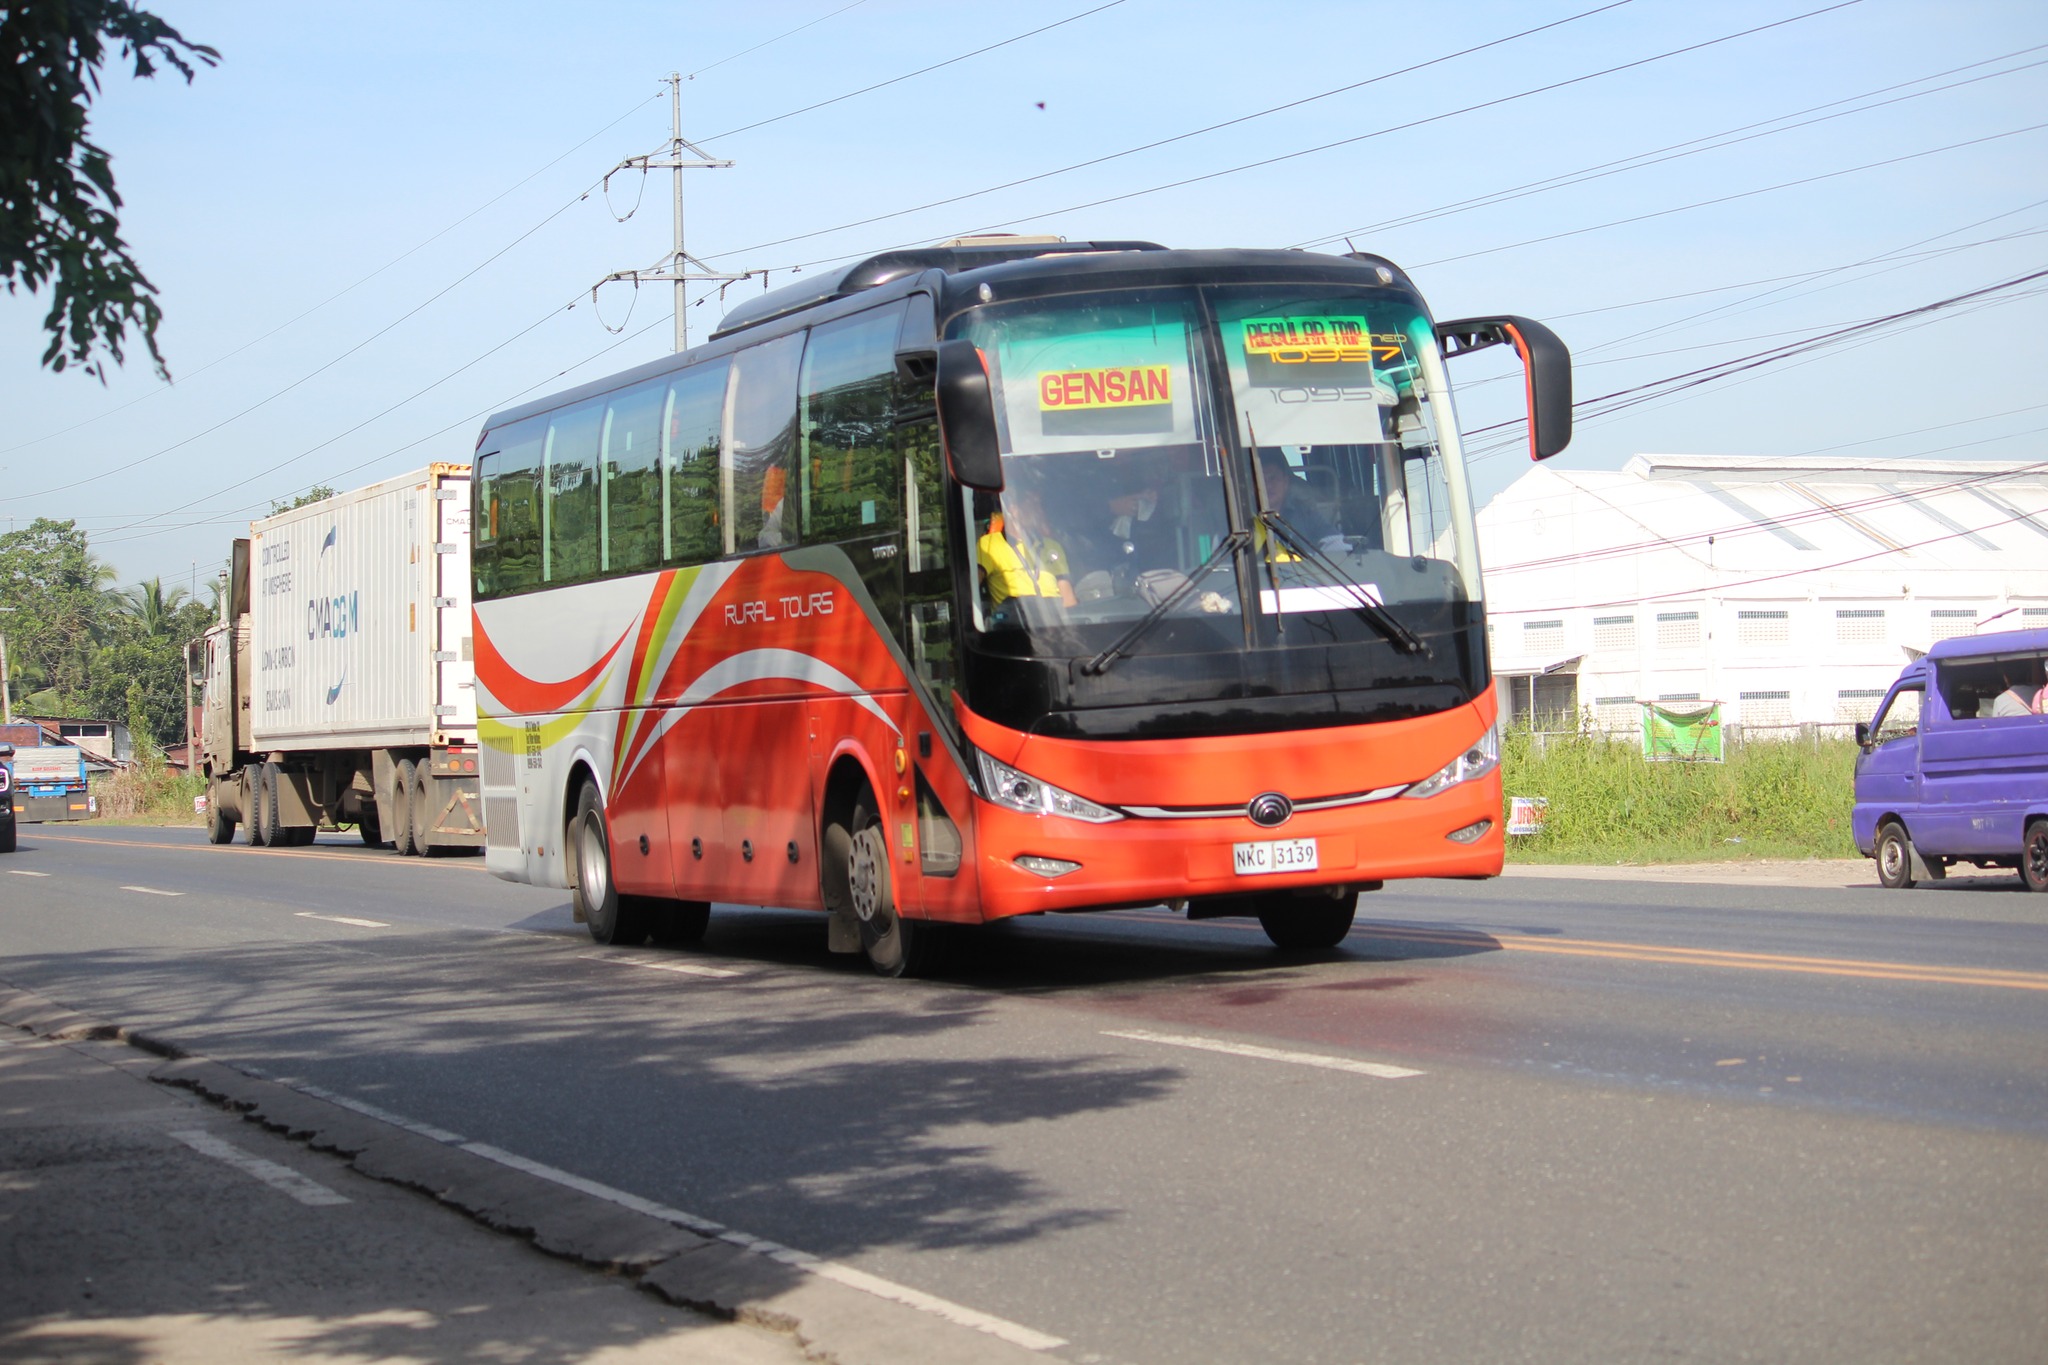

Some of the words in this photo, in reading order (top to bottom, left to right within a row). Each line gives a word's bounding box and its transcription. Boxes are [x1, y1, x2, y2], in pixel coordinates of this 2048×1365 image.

[1246, 320, 1328, 348] REGULAR
[1329, 319, 1363, 346] TRIP
[1041, 368, 1169, 406] GENSAN
[725, 600, 776, 626] RURAL
[779, 591, 834, 619] TOURS
[1236, 849, 1266, 867] NKC
[1276, 846, 1314, 864] 3139
